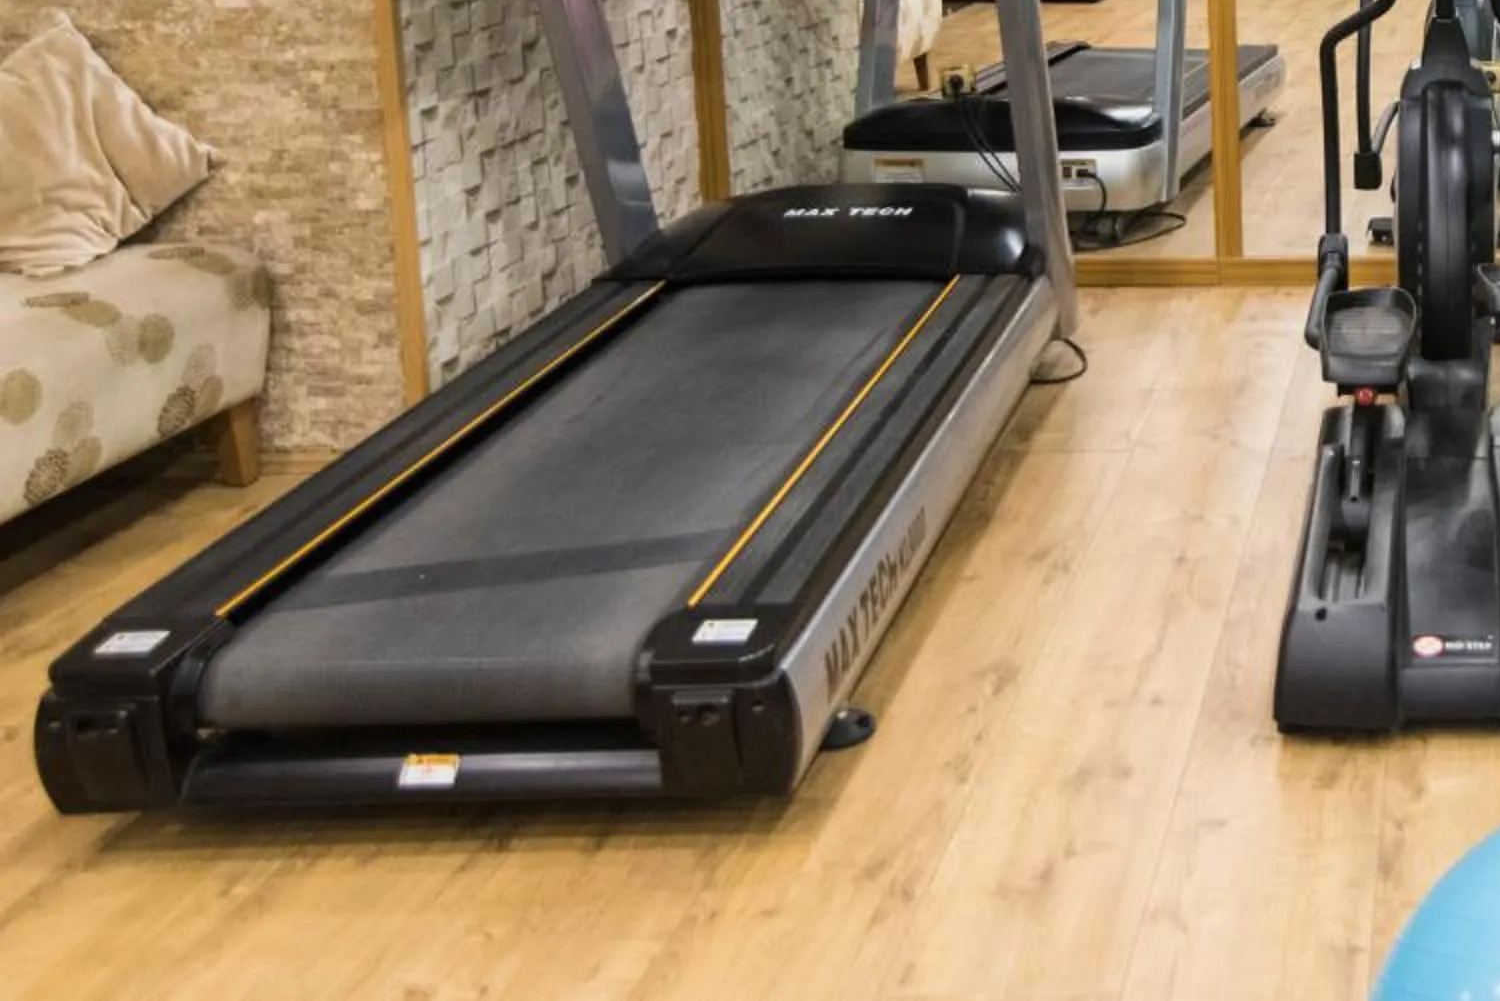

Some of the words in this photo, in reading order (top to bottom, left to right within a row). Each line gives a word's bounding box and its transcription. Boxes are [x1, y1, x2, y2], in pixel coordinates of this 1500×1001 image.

[783, 207, 840, 217] MAX
[848, 206, 913, 217] TECH
[859, 552, 898, 643] TECH
